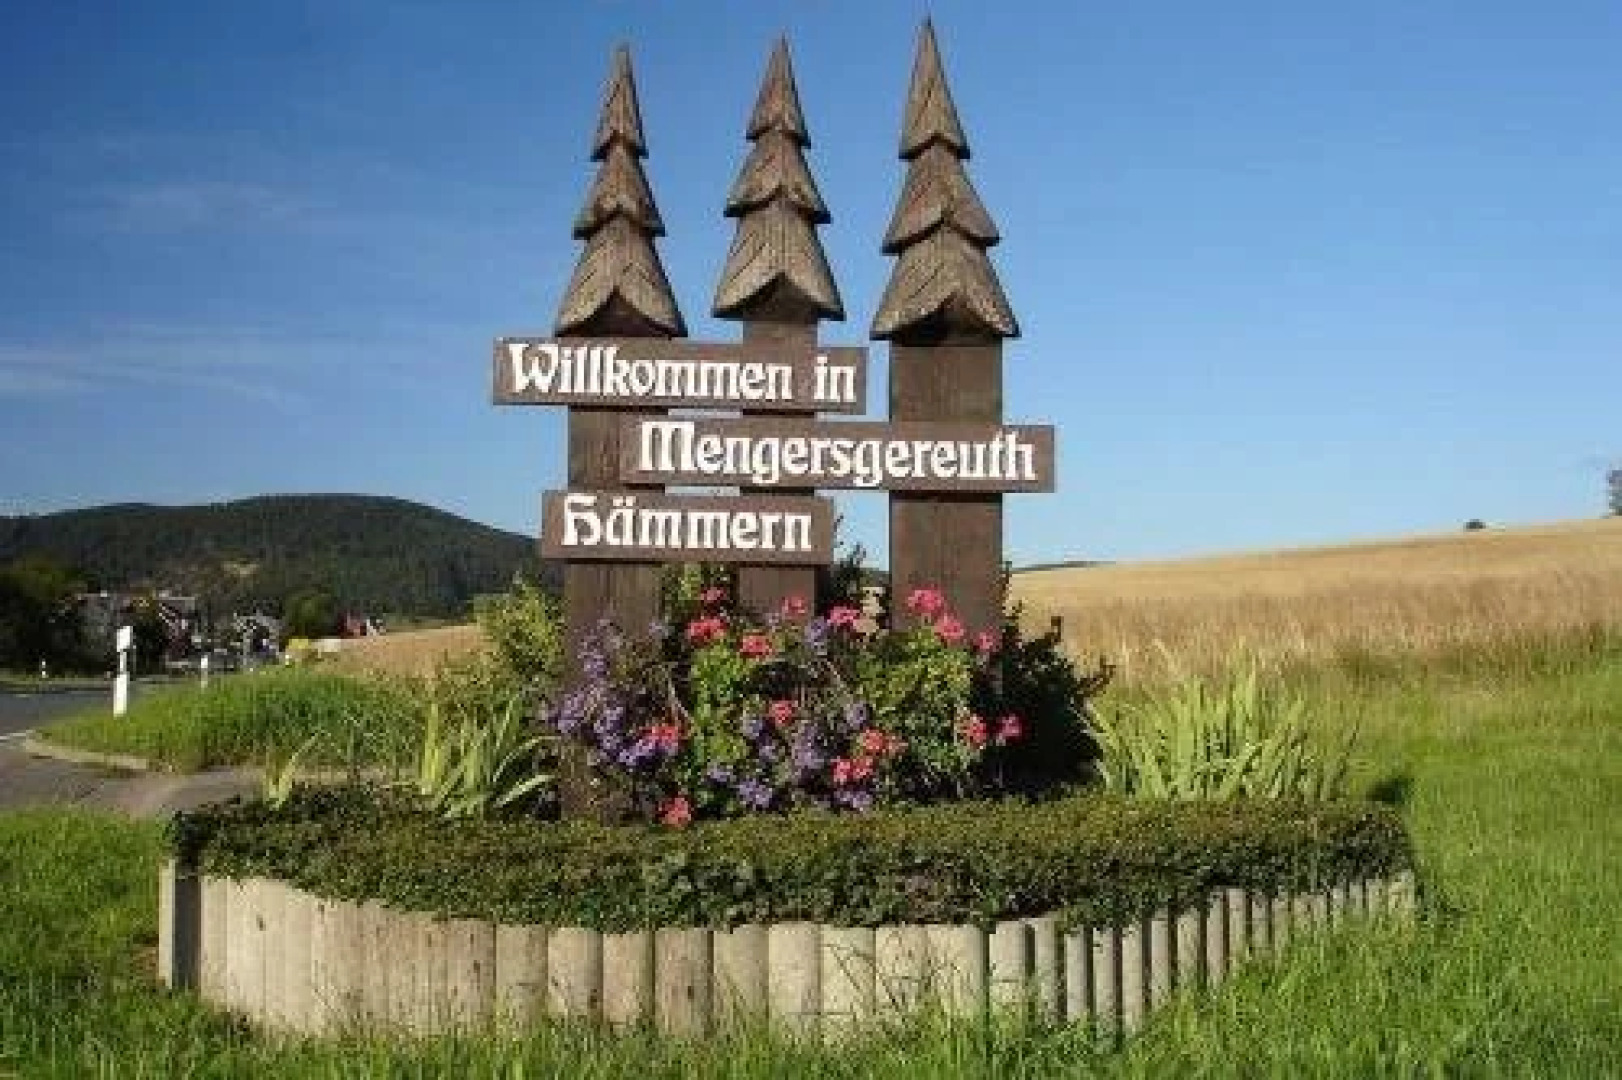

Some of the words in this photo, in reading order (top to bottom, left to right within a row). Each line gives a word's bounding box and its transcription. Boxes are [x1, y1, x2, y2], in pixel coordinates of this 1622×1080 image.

[508, 341, 793, 401] Willkommen
[813, 354, 857, 402] in
[639, 420, 1037, 487] Mengersgereuth
[561, 493, 812, 552] Hämmern
